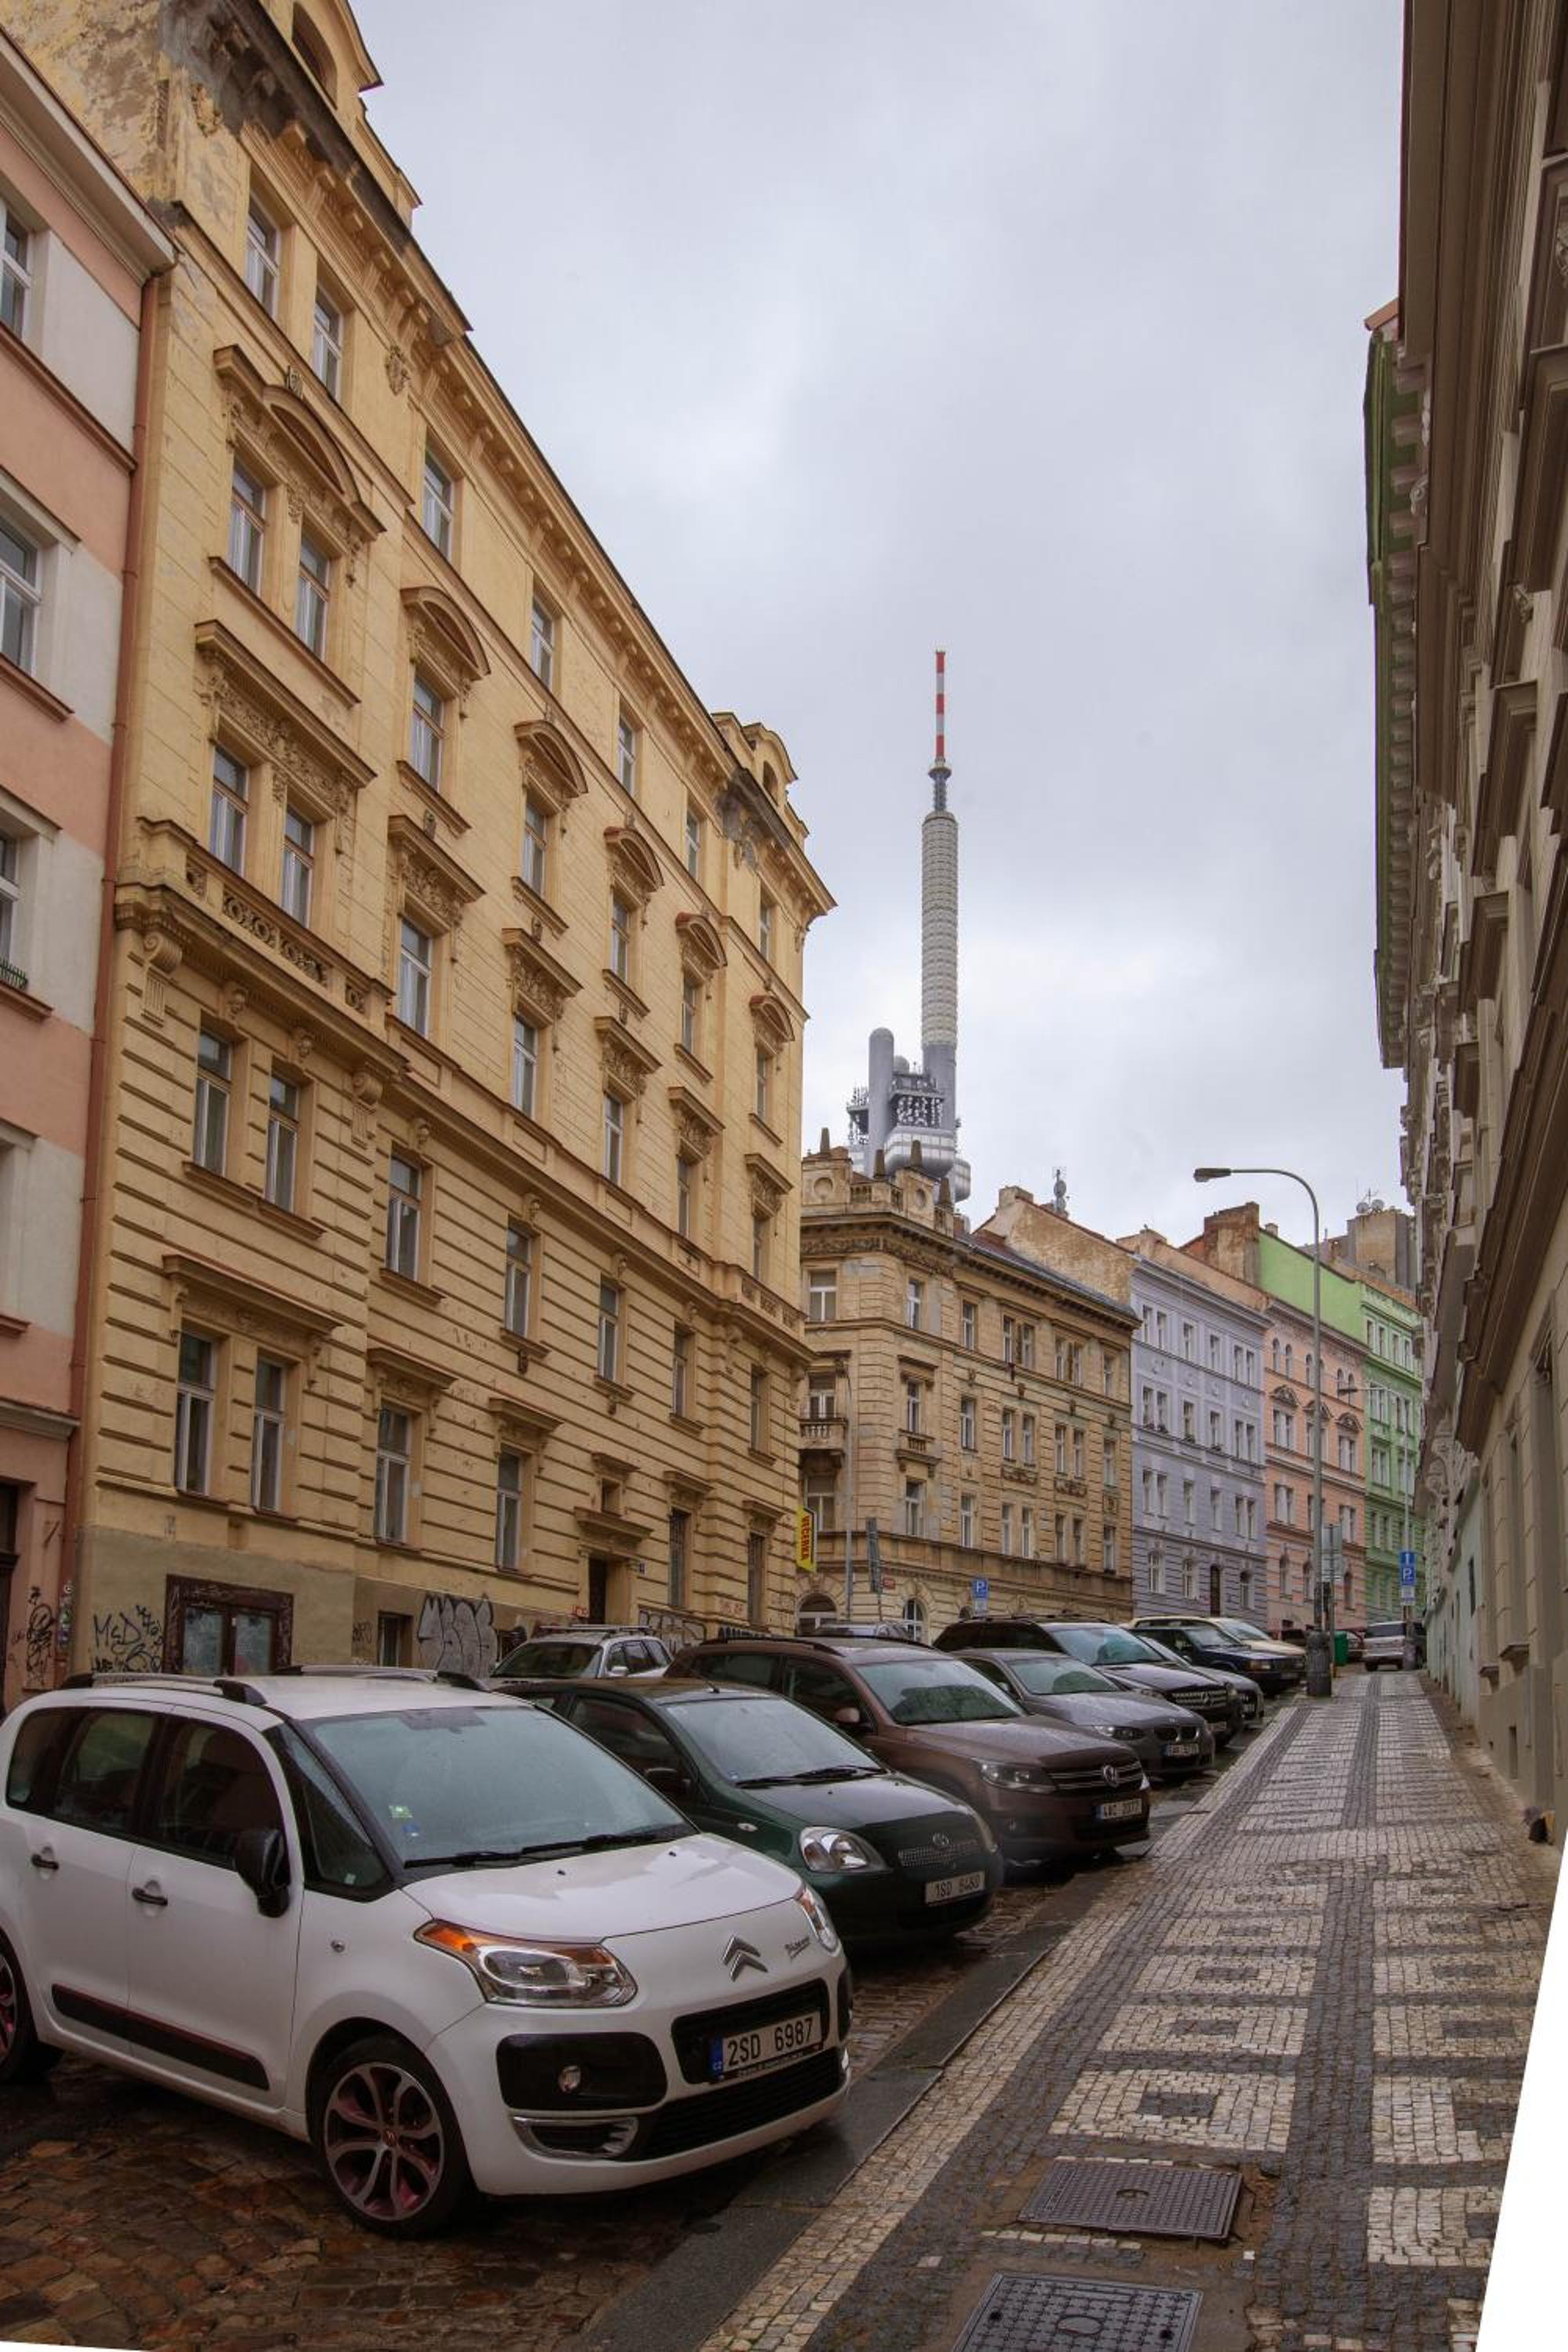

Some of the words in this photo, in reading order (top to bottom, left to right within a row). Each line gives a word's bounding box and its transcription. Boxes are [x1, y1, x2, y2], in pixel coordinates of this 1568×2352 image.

[1403, 1567, 1412, 1580] P
[976, 1580, 985, 1593] P
[727, 2034, 761, 2067] 2SD
[774, 2017, 814, 2052] 6987
